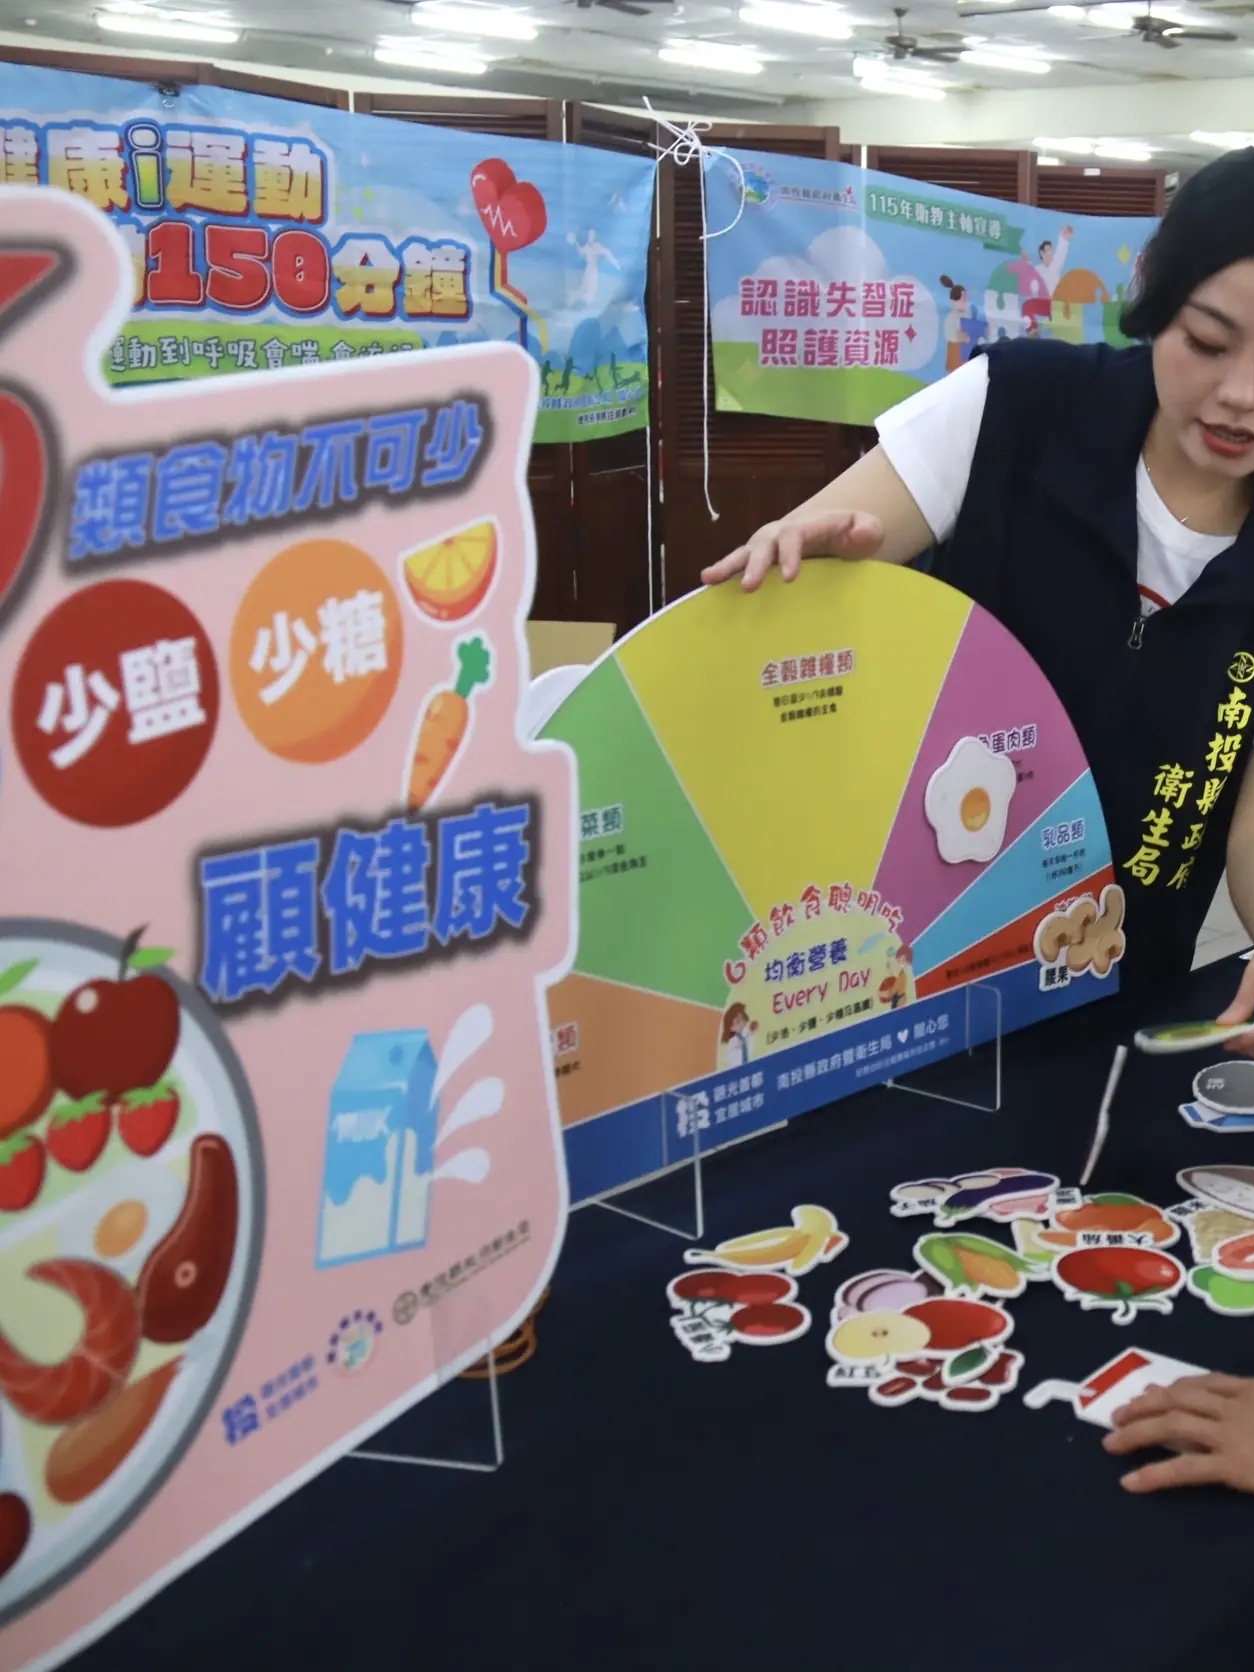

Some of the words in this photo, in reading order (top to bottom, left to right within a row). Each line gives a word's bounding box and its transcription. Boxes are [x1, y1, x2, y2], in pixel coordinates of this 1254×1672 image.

[118, 223, 470, 318] 150分鐘
[740, 277, 915, 319] 認識失智症
[761, 328, 902, 368] 照護資源
[68, 399, 483, 561] 類食物不可少
[247, 589, 389, 706] 少糖
[762, 649, 853, 686] 全穀雜糧類
[37, 636, 207, 770] 少鹽
[1043, 820, 1084, 848] 乳品類
[1123, 762, 1195, 886] 衛生局
[200, 802, 530, 1002] 顧健康
[764, 937, 847, 983] 均衡營養
[772, 983, 828, 1015] Every
[839, 968, 871, 993] Day
[1081, 1232, 1149, 1246] 大番茄
